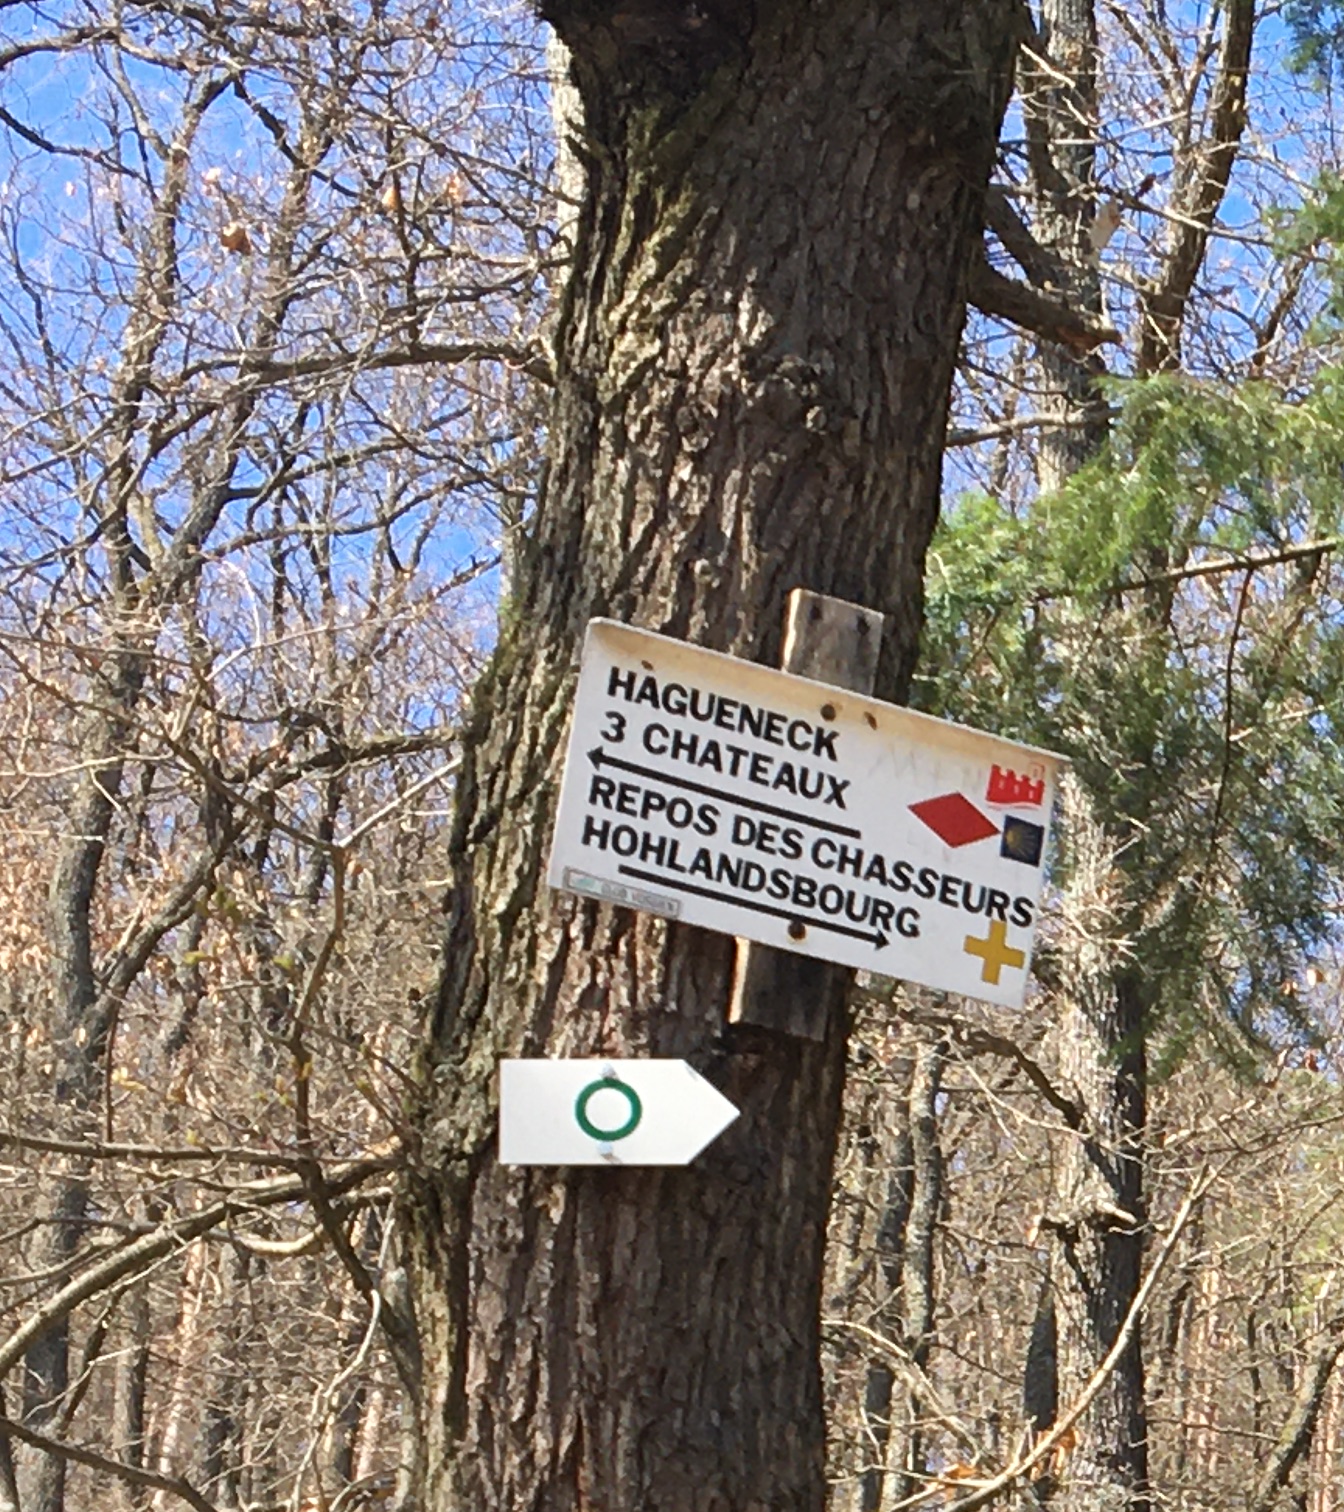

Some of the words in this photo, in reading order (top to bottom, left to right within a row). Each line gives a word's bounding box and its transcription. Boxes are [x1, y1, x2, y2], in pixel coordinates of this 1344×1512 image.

[600, 711, 627, 743] 3
[642, 723, 850, 810] CHATEAUX
[607, 665, 839, 761] HAGUENECK
[581, 815, 920, 938] HOHLANDSBOURG
[588, 774, 720, 836] REPOS
[731, 814, 804, 860] DES
[811, 838, 1035, 928] CHASSEURS
